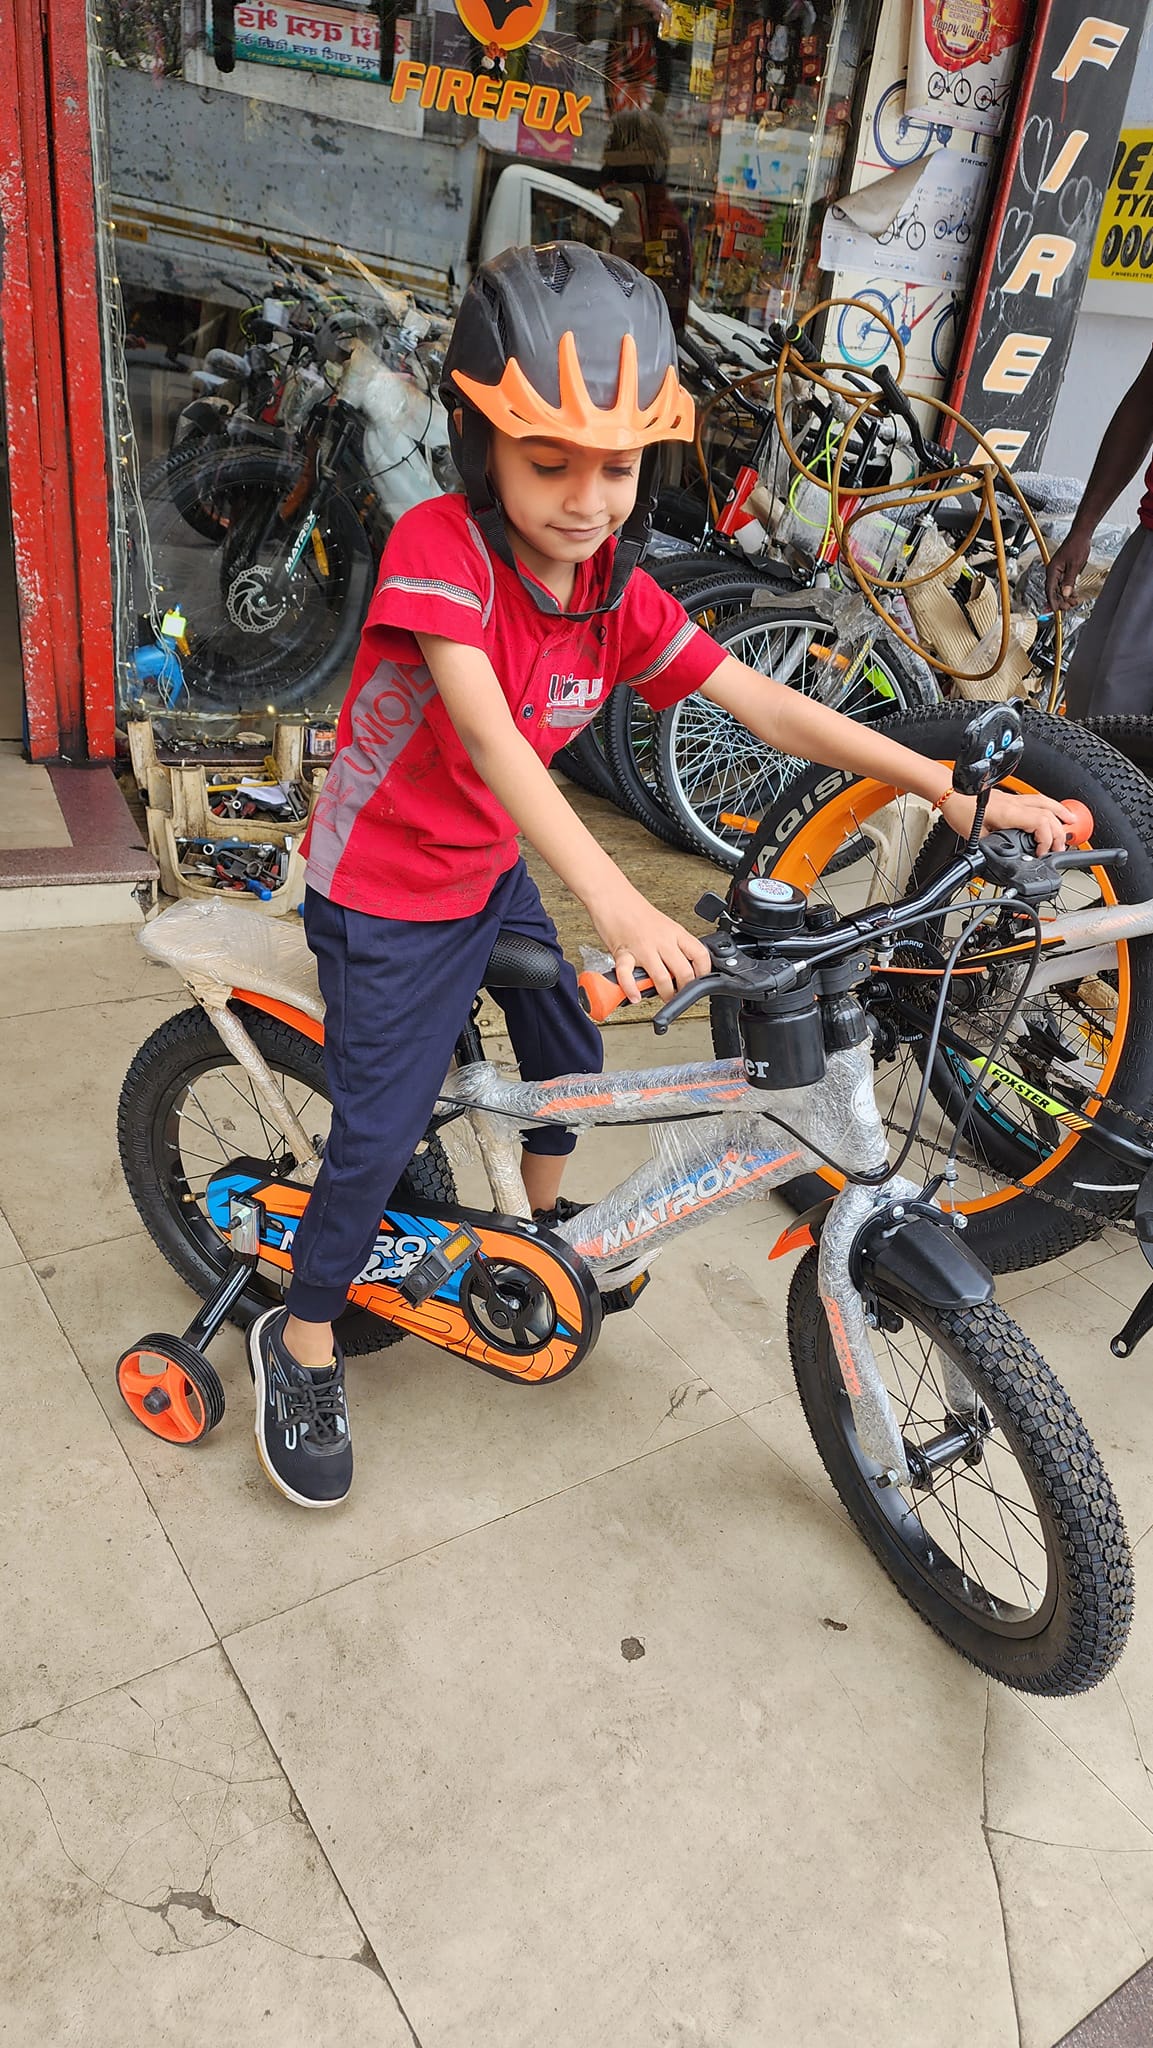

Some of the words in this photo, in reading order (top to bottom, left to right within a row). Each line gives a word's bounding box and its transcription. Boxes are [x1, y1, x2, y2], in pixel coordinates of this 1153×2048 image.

[932, 15, 959, 37] Happy
[961, 23, 991, 41] Diwali
[391, 61, 592, 137] FIREFOX
[961, 158, 989, 168] STRYDER
[895, 939, 924, 949] HIMANO
[744, 1058, 770, 1078] er
[991, 1068, 1051, 1110] FOXSTER
[602, 1151, 751, 1255] MATROX
